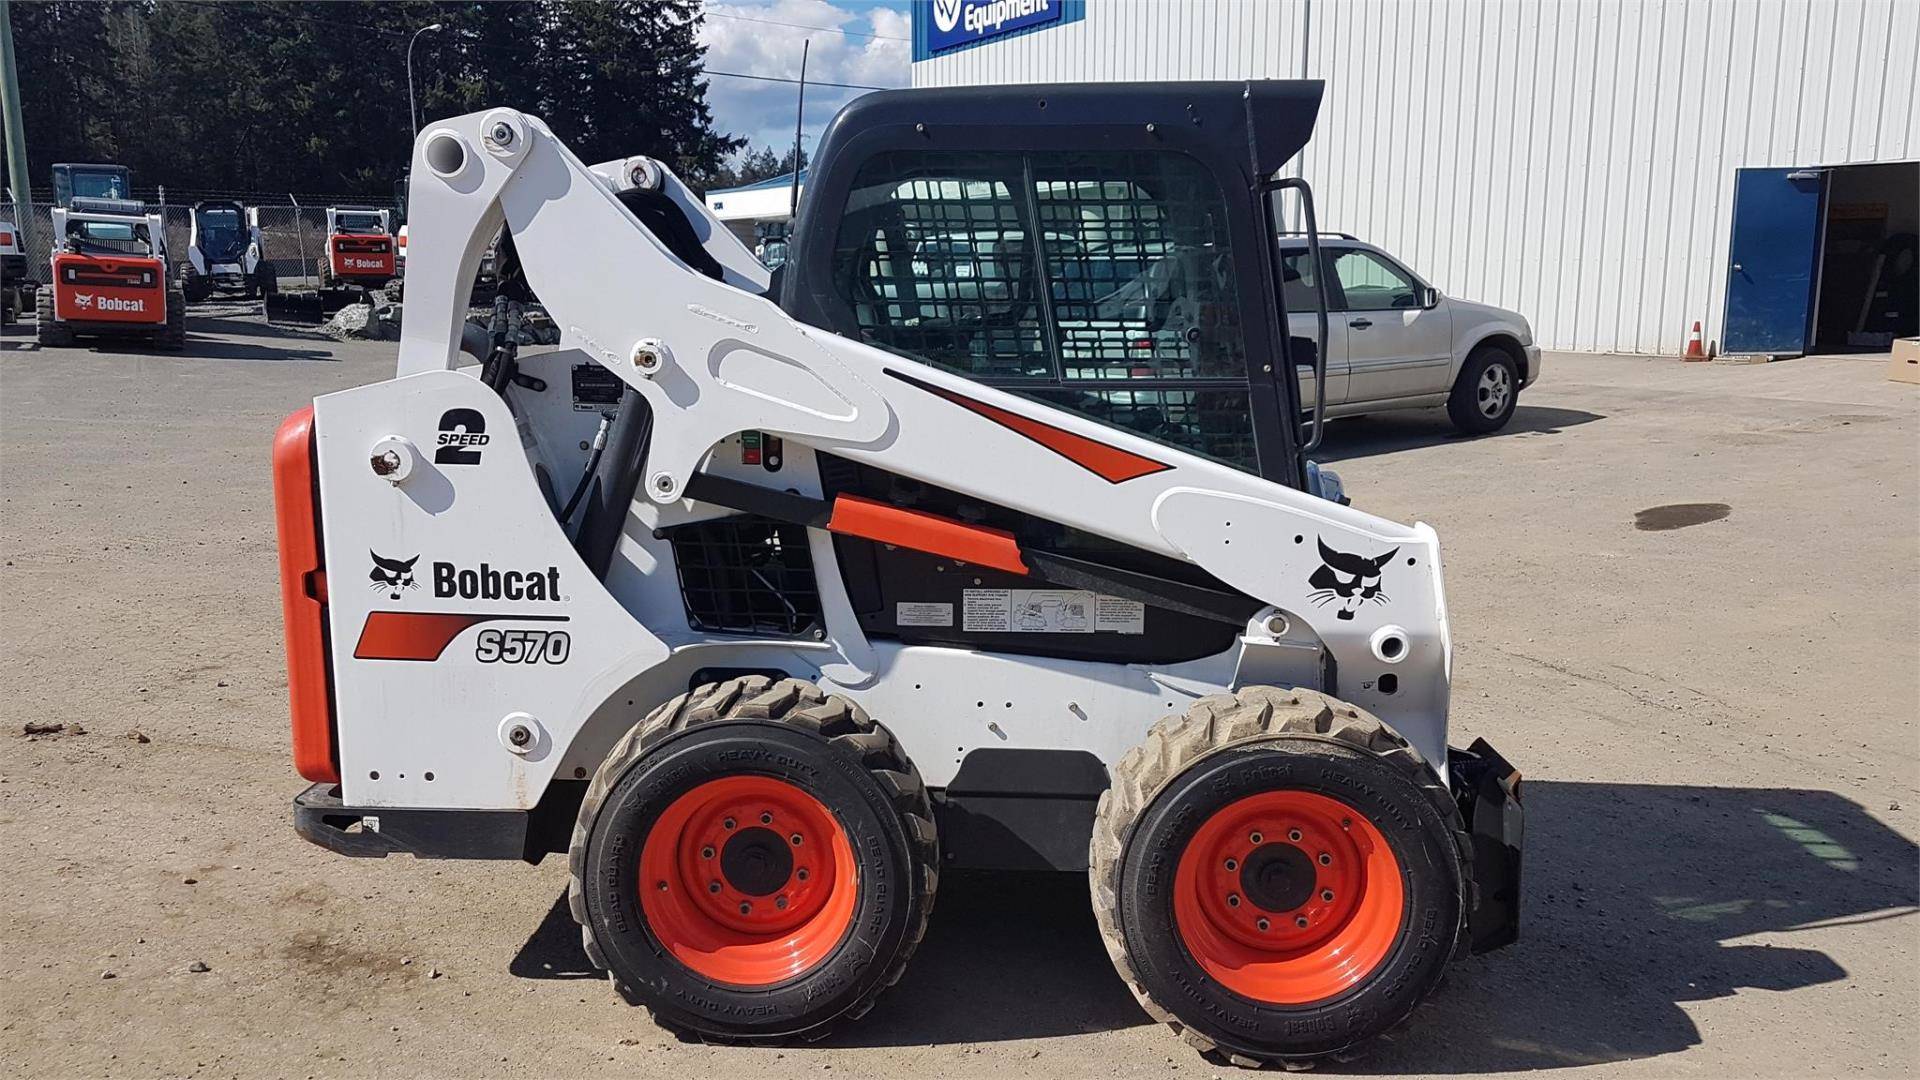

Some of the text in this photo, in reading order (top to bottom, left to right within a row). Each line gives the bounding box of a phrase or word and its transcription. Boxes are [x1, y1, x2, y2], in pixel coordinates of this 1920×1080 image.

[964, 0, 1049, 34] Equipment
[356, 259, 384, 268] Bobcat
[97, 296, 144, 312] Bobcat
[434, 408, 486, 465] 2
[436, 433, 490, 447] SPEED
[433, 561, 561, 601] Bobcat
[475, 629, 571, 664] S570
